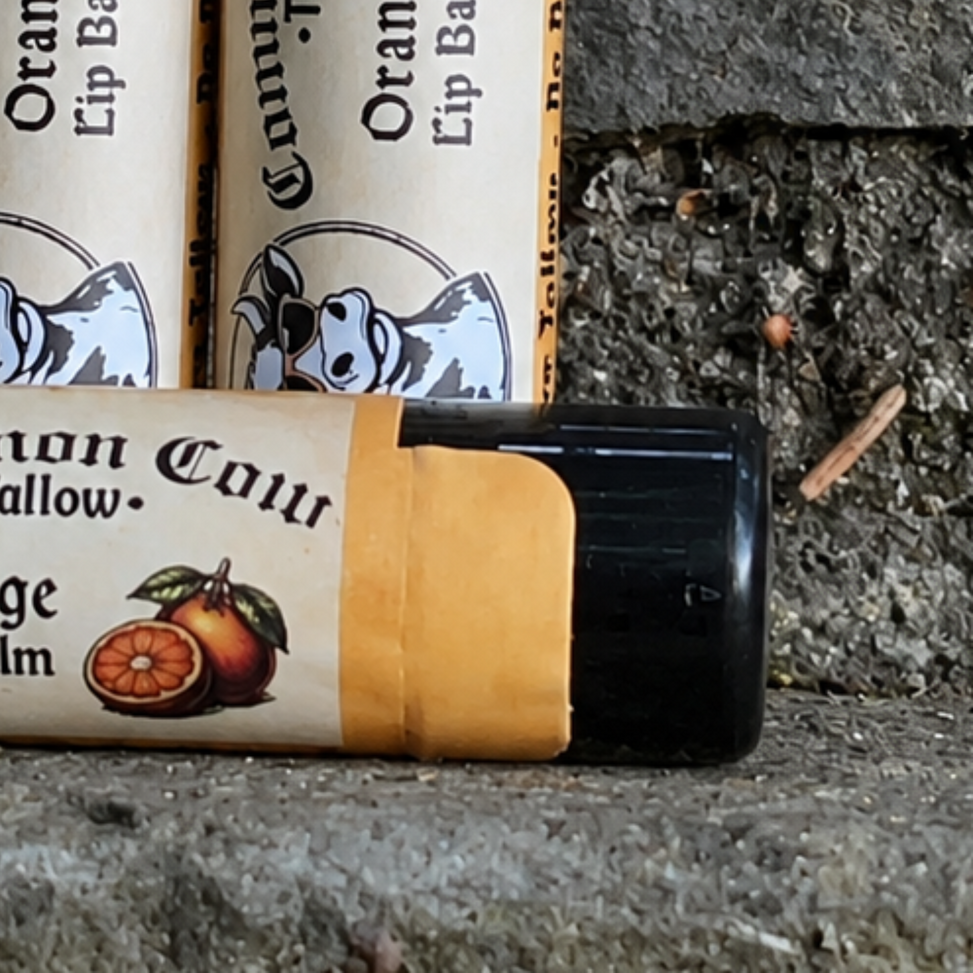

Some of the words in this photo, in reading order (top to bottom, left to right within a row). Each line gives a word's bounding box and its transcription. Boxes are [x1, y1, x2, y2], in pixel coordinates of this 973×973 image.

[73, 65, 127, 136] Lip
[432, 74, 483, 147] Lip
[155, 436, 336, 529] Cow
